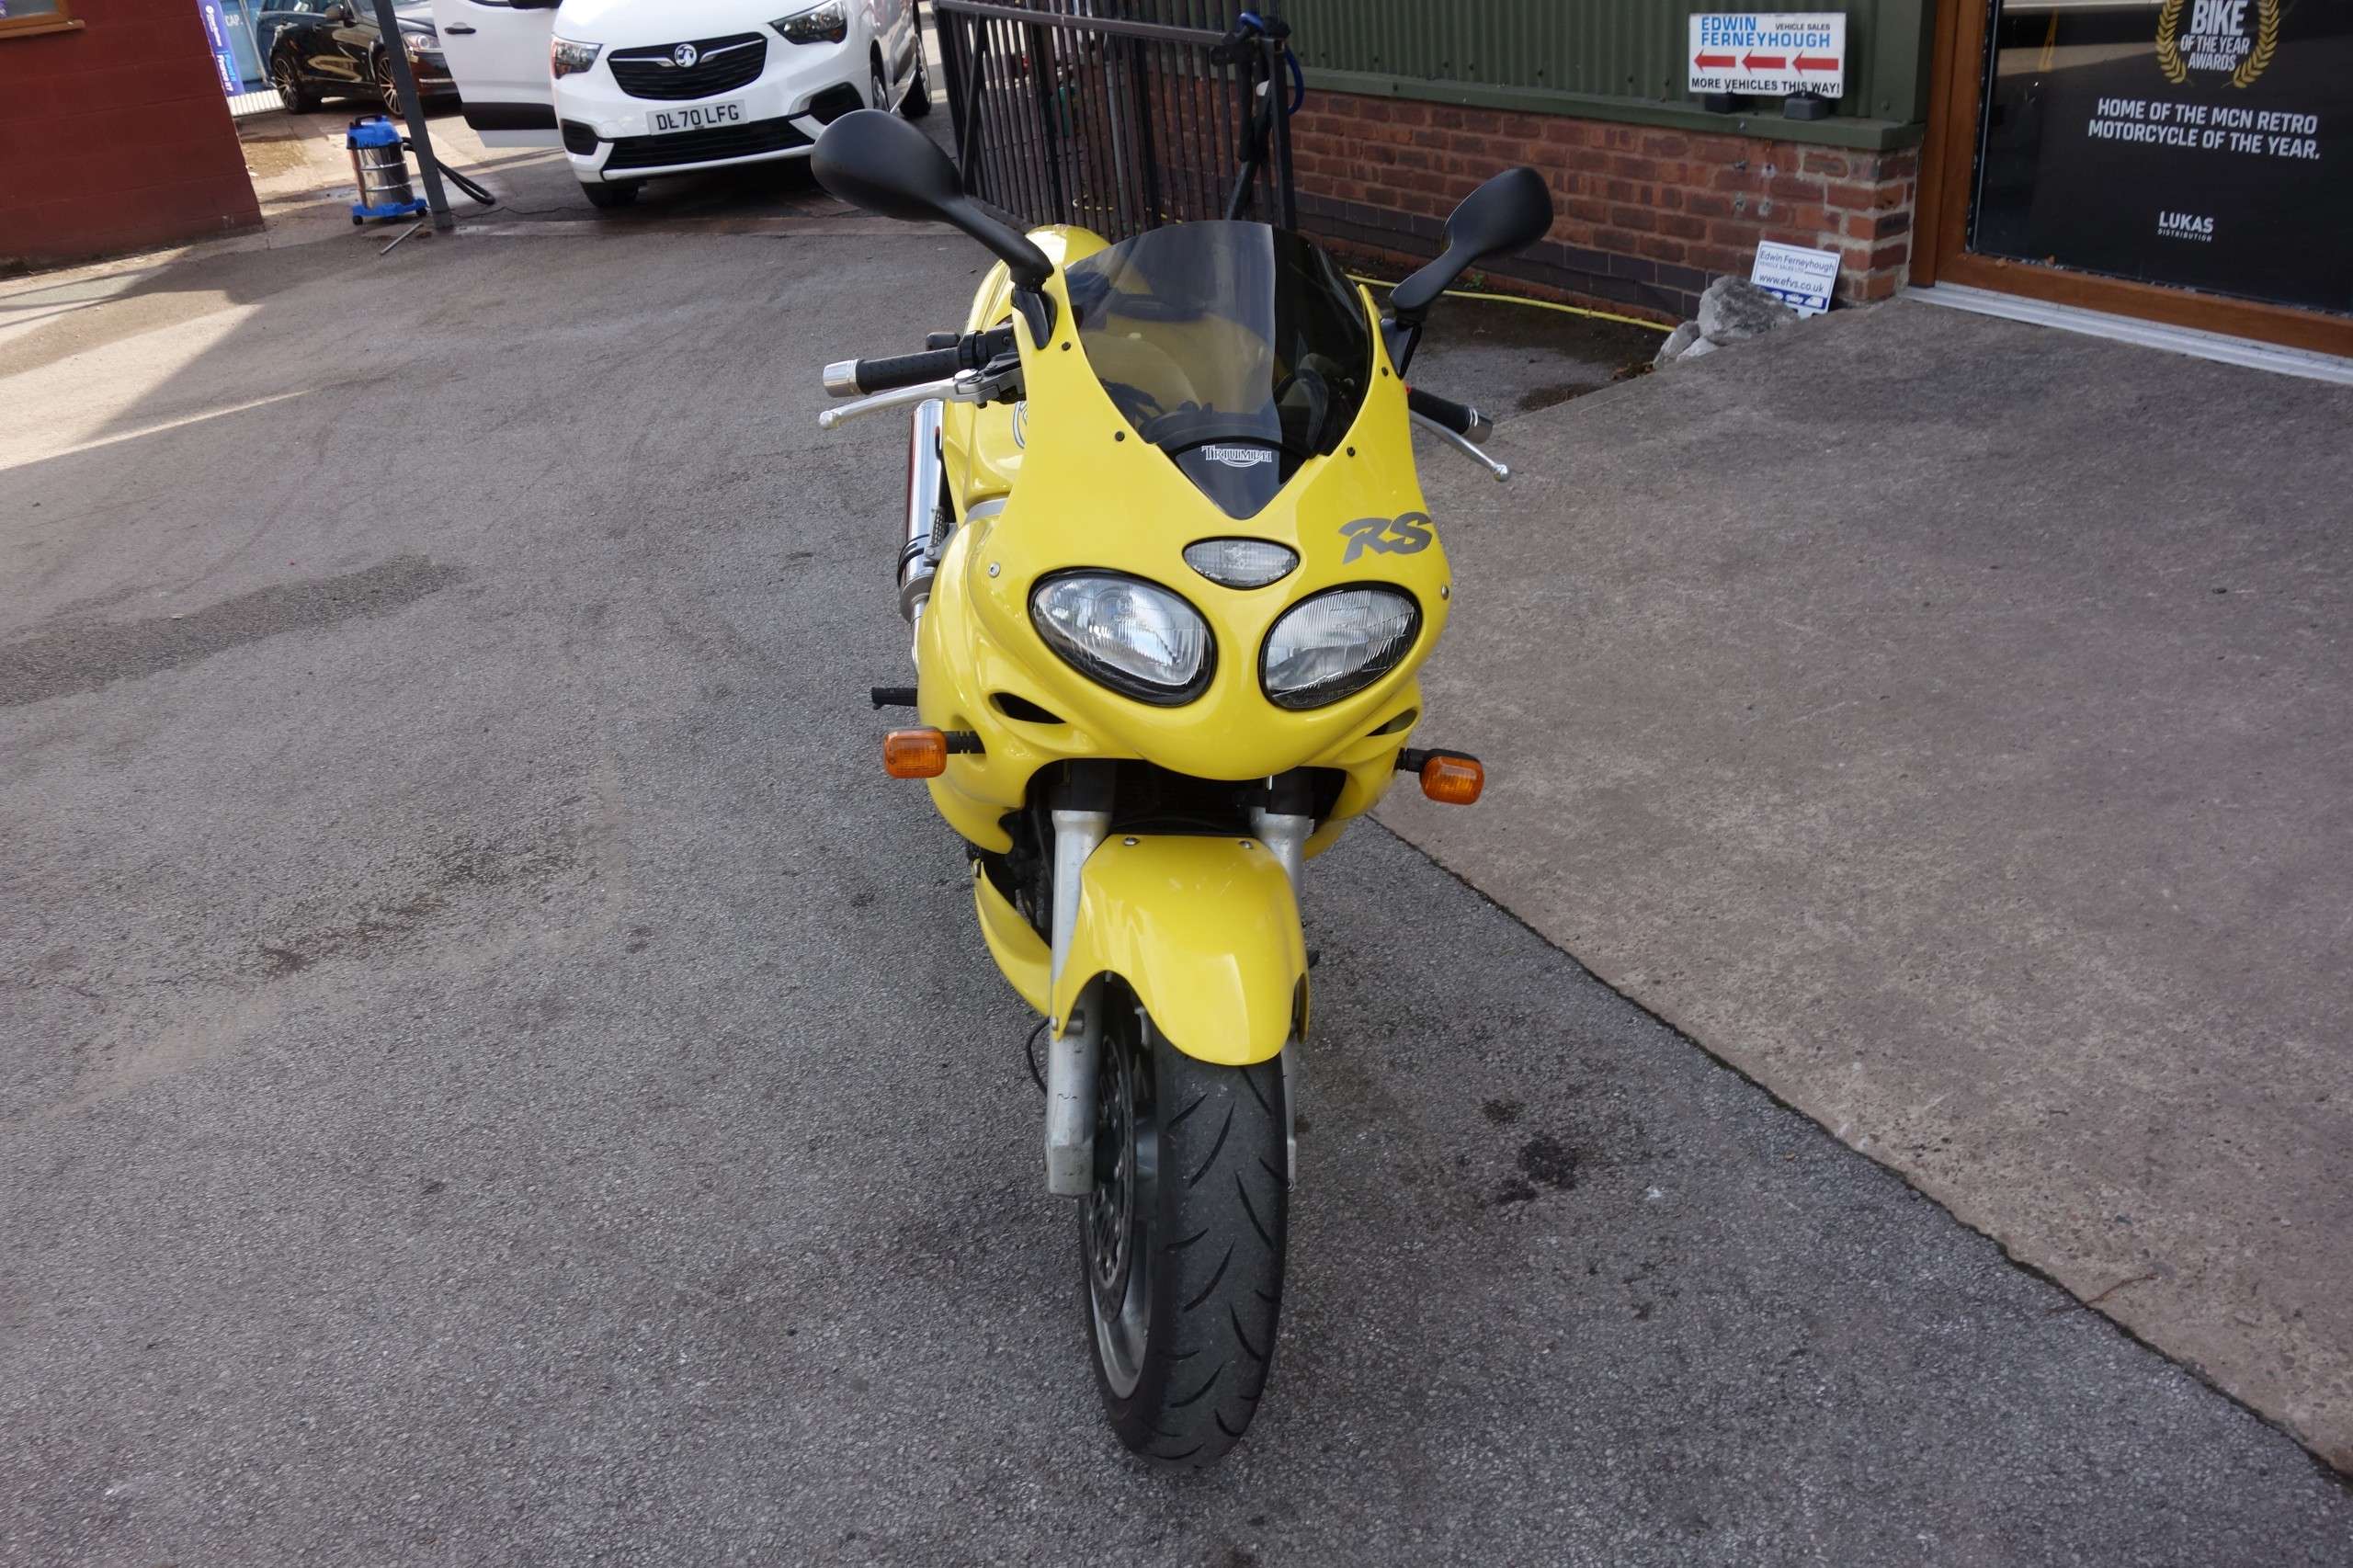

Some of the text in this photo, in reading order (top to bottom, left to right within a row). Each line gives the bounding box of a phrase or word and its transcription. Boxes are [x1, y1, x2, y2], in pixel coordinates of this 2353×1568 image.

[1701, 17, 1756, 31] EDWIN
[2190, 0, 2248, 36] BIKE
[1701, 32, 1831, 48] FERNEYHOUGH
[2179, 34, 2250, 54] OF THE YEAR
[2188, 52, 2237, 71] AWARDS
[1691, 77, 1840, 94] MORE VEHICLES THIS WAY!
[655, 104, 739, 131] DL70 LFG
[2097, 97, 2318, 135] HOME OF THE MCN RETRO
[2087, 119, 2321, 160] MOTORCYCLE OF THE YEAR.
[2158, 210, 2214, 233] LUKAS
[2156, 228, 2212, 243] DISTRIBUTION
[1759, 250, 1835, 273] Edwin Ferneyhough
[1758, 274, 1824, 292] www.efvs.co.uk
[1201, 445, 1273, 466] TRIUMPH
[1338, 511, 1434, 564] RS
